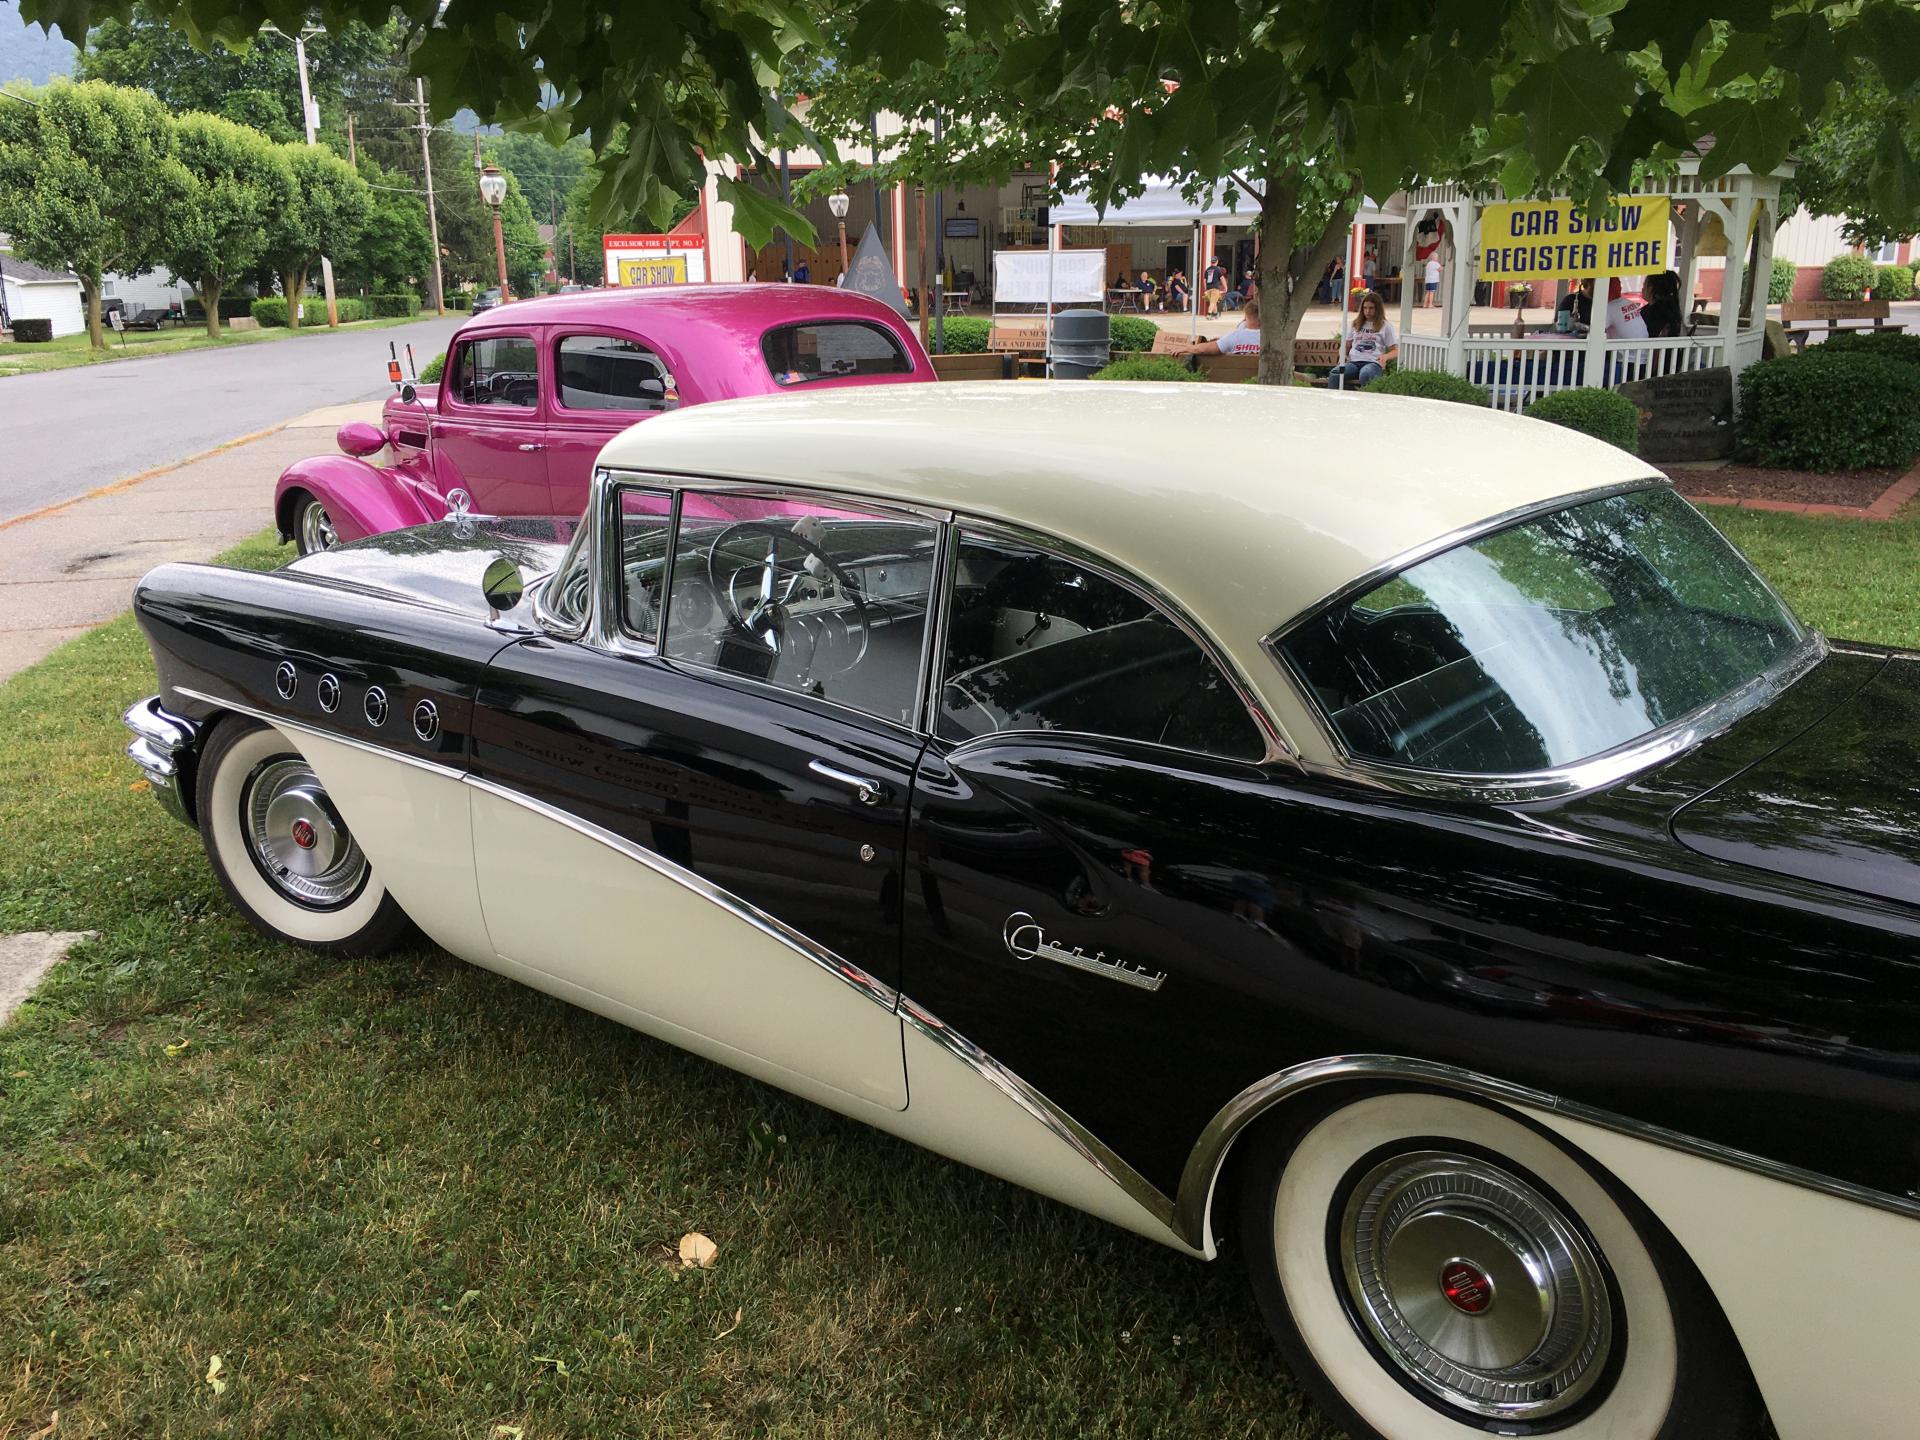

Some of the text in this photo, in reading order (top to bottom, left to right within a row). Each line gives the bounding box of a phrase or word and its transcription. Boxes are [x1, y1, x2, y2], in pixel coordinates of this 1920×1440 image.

[1510, 210, 1559, 237] CAR
[1486, 240, 1661, 272] REGISTER HERE
[630, 265, 675, 286] CAR SHOW
[1306, 342, 1341, 351] MEMO
[1304, 355, 1332, 364] ANNA
[1003, 911, 1168, 990] Century
